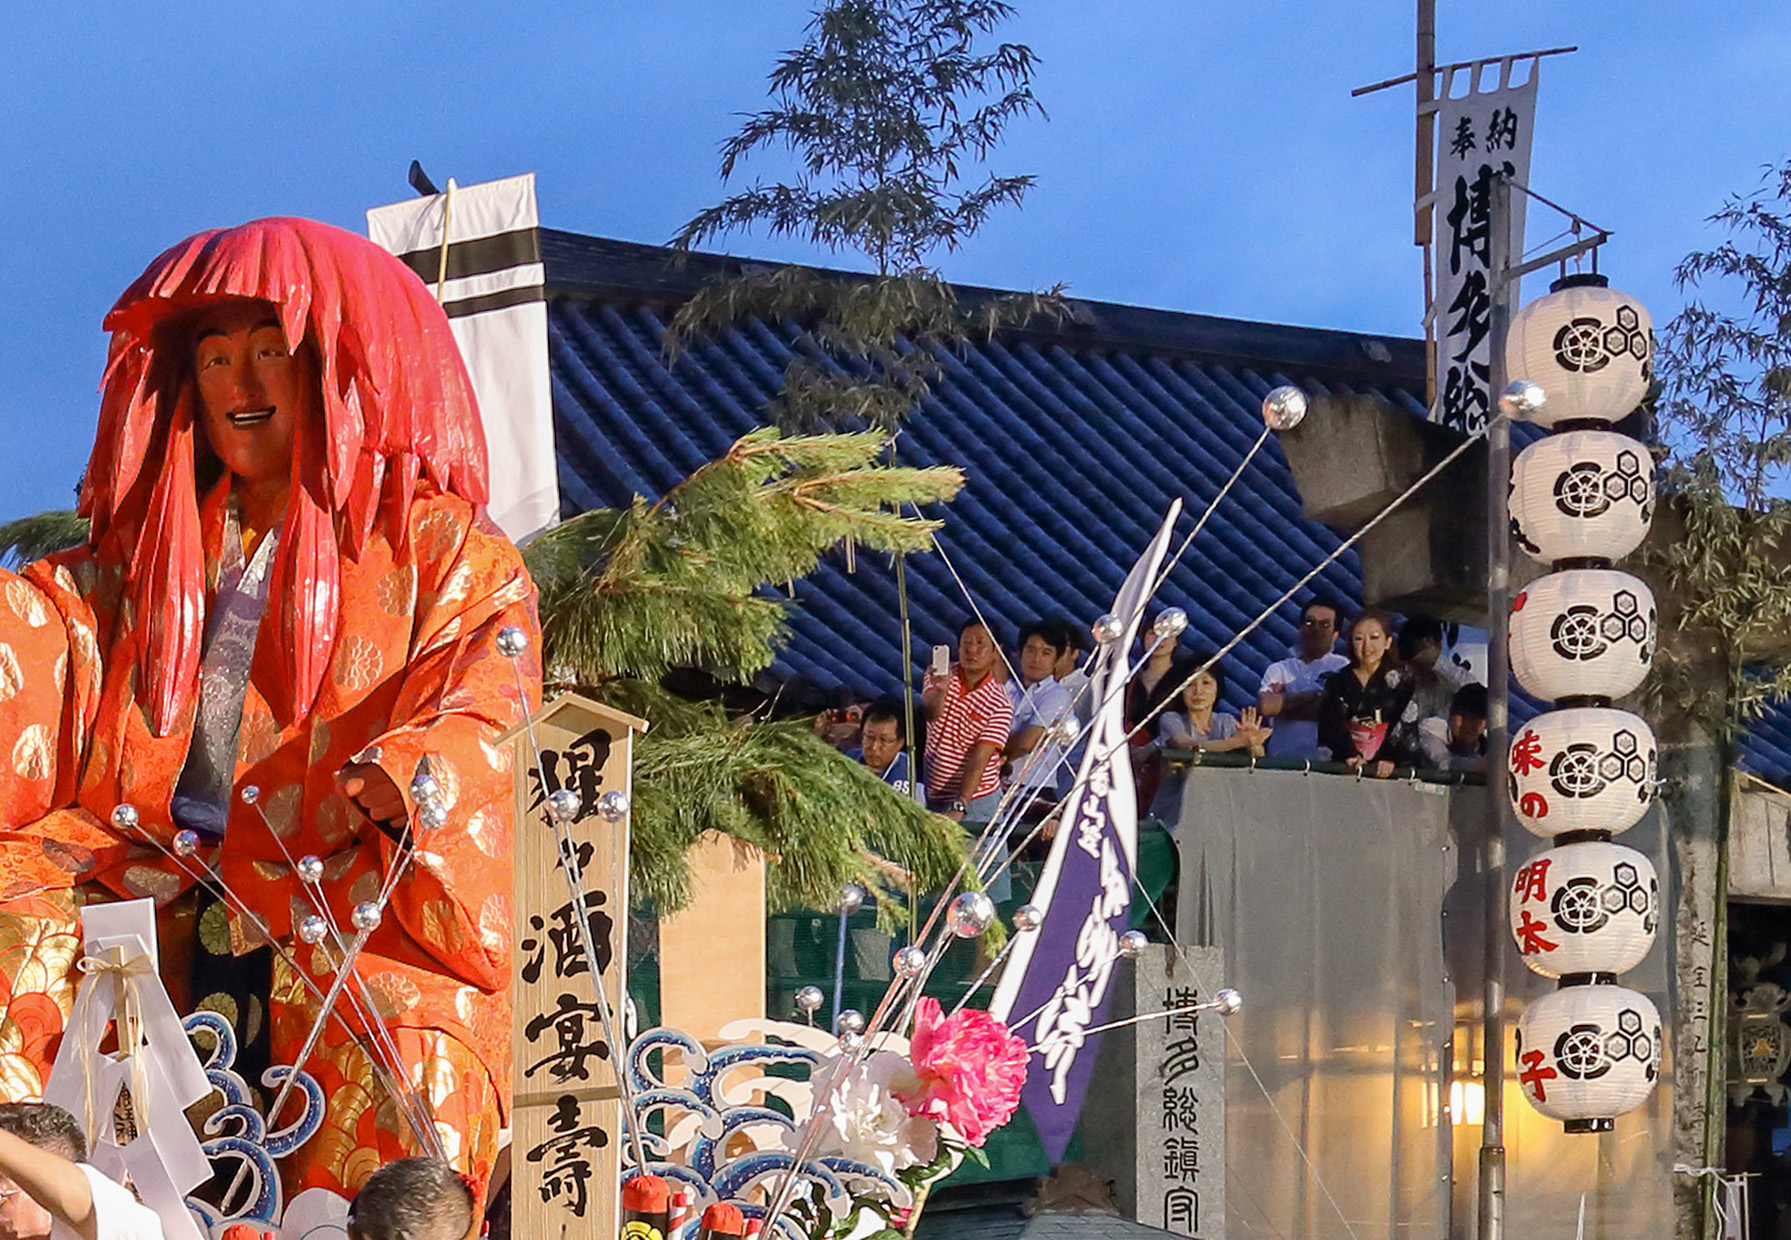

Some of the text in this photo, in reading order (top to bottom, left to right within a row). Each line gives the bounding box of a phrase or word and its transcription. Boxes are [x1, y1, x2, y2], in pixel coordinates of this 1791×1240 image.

[1451, 107, 1519, 160] 奉納
[1511, 729, 1559, 1102] 味の 明太 子
